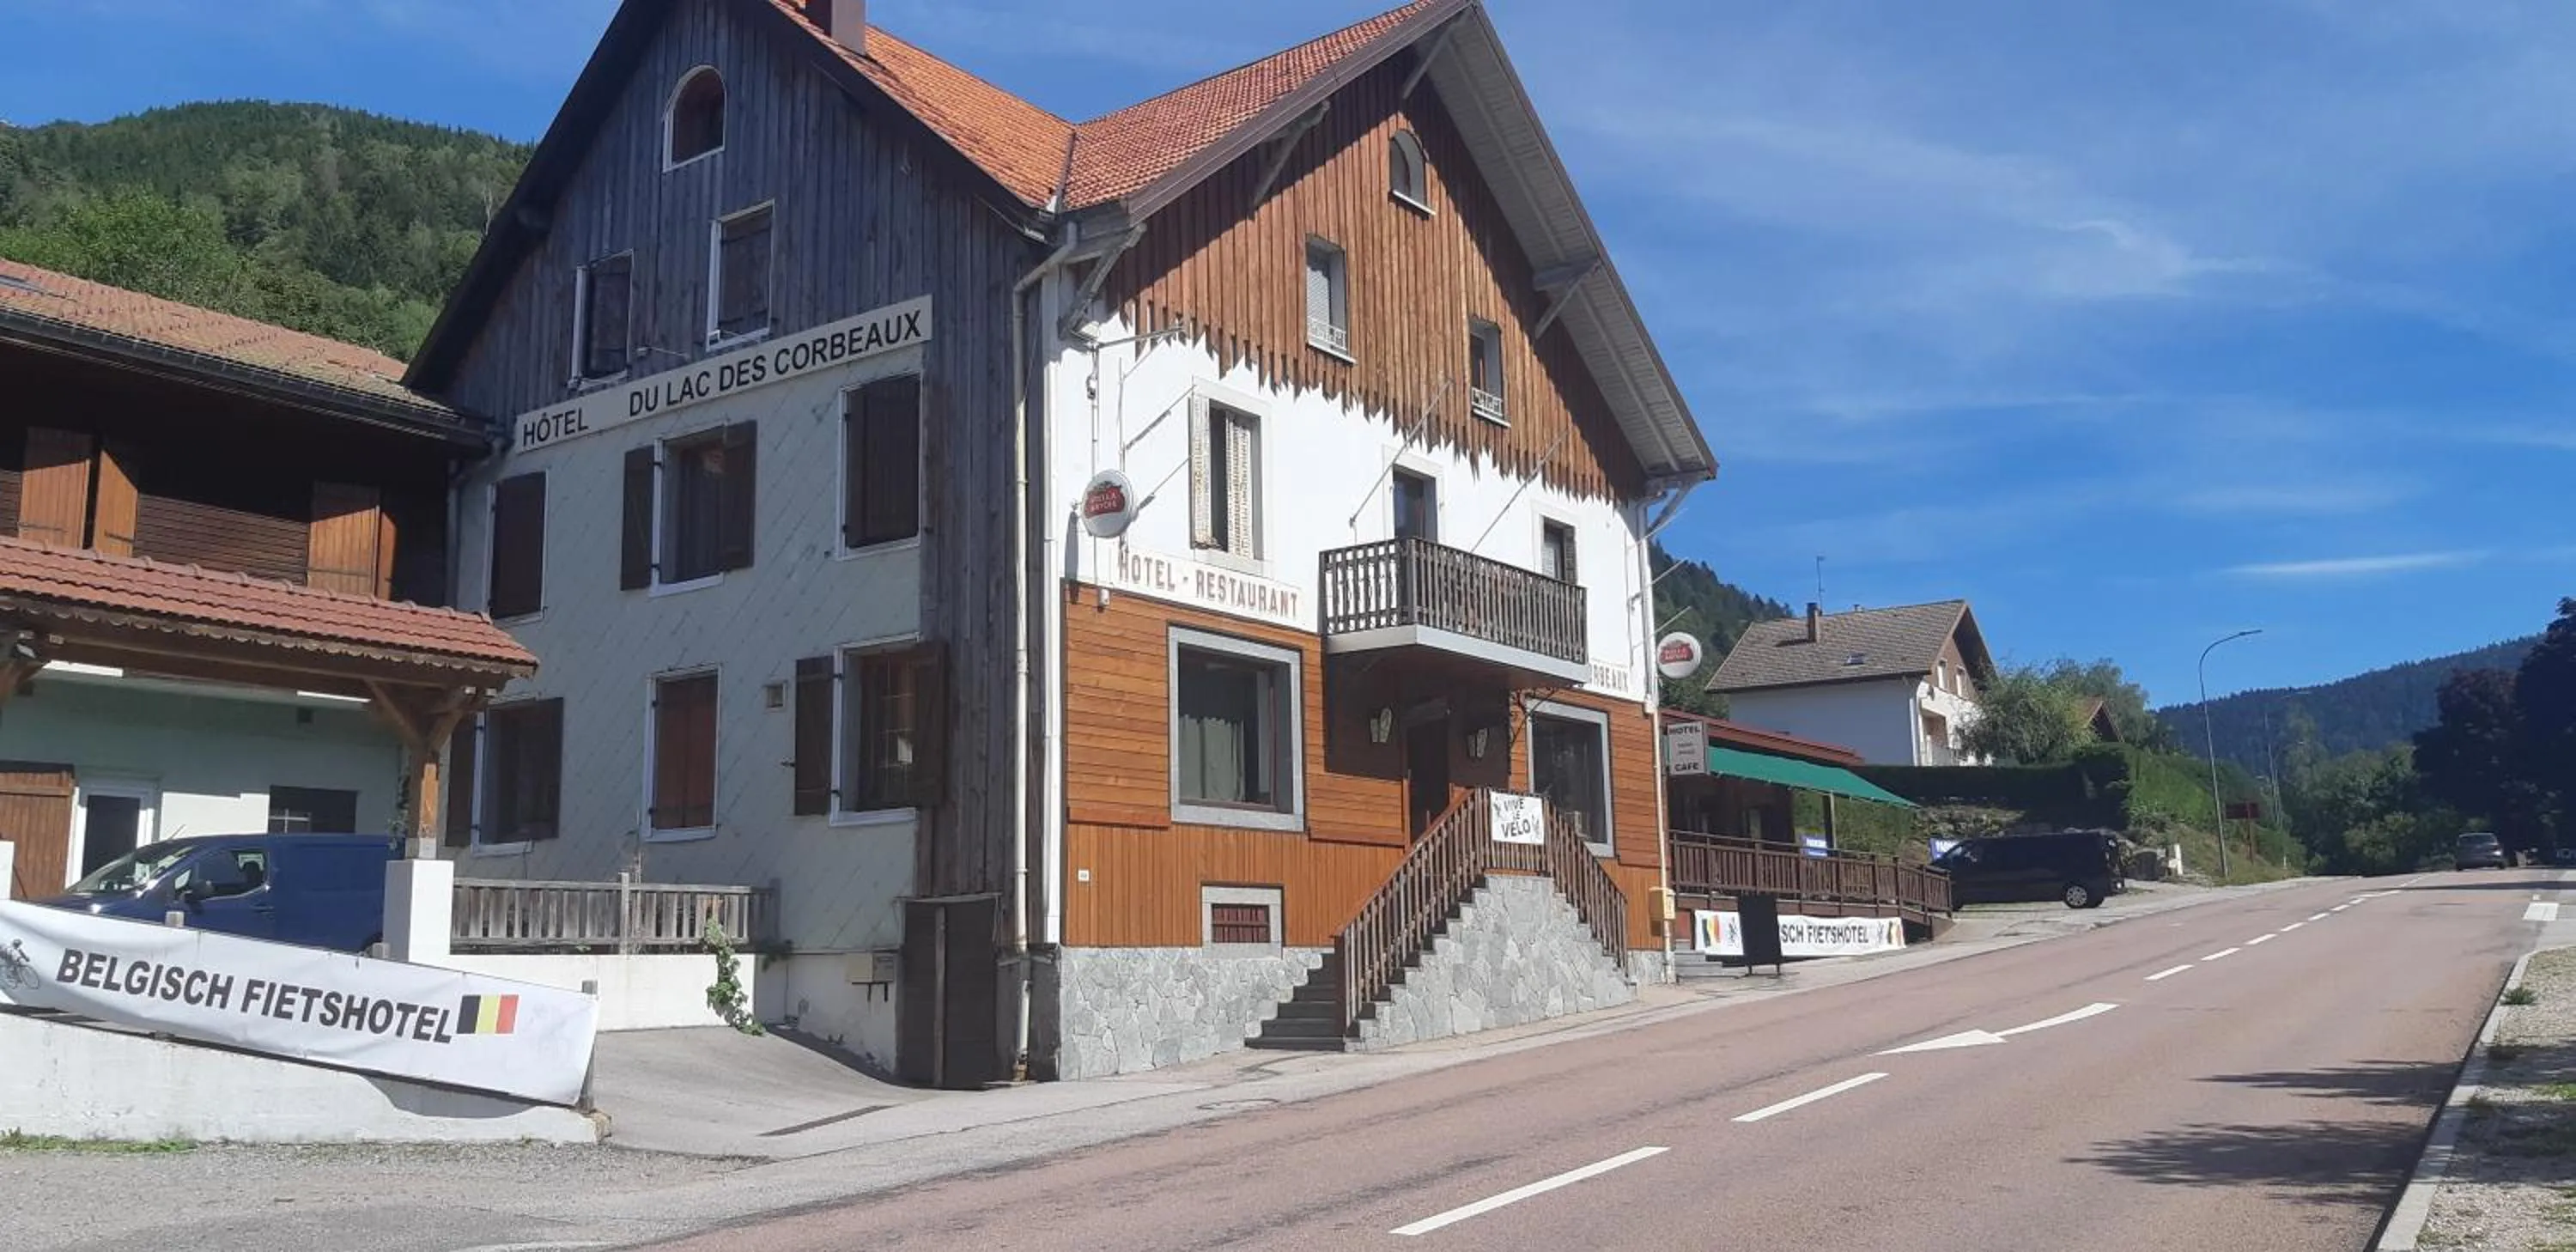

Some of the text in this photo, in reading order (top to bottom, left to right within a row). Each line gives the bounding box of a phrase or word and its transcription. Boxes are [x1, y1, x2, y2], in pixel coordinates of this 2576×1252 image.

[522, 310, 922, 447] HÔTEL DU LAC DES CORBEAUX
[1118, 550, 1176, 592] HOTEL
[1195, 569, 1298, 618] RESTAURANT
[1589, 663, 1629, 693] RBEAUX
[1504, 798, 1524, 811] VIVE
[1512, 810, 1521, 821] LE
[1781, 924, 1869, 944] SCH FIETSHOTEL
[57, 948, 455, 1044] BELGISCH FIETSHOTEL
